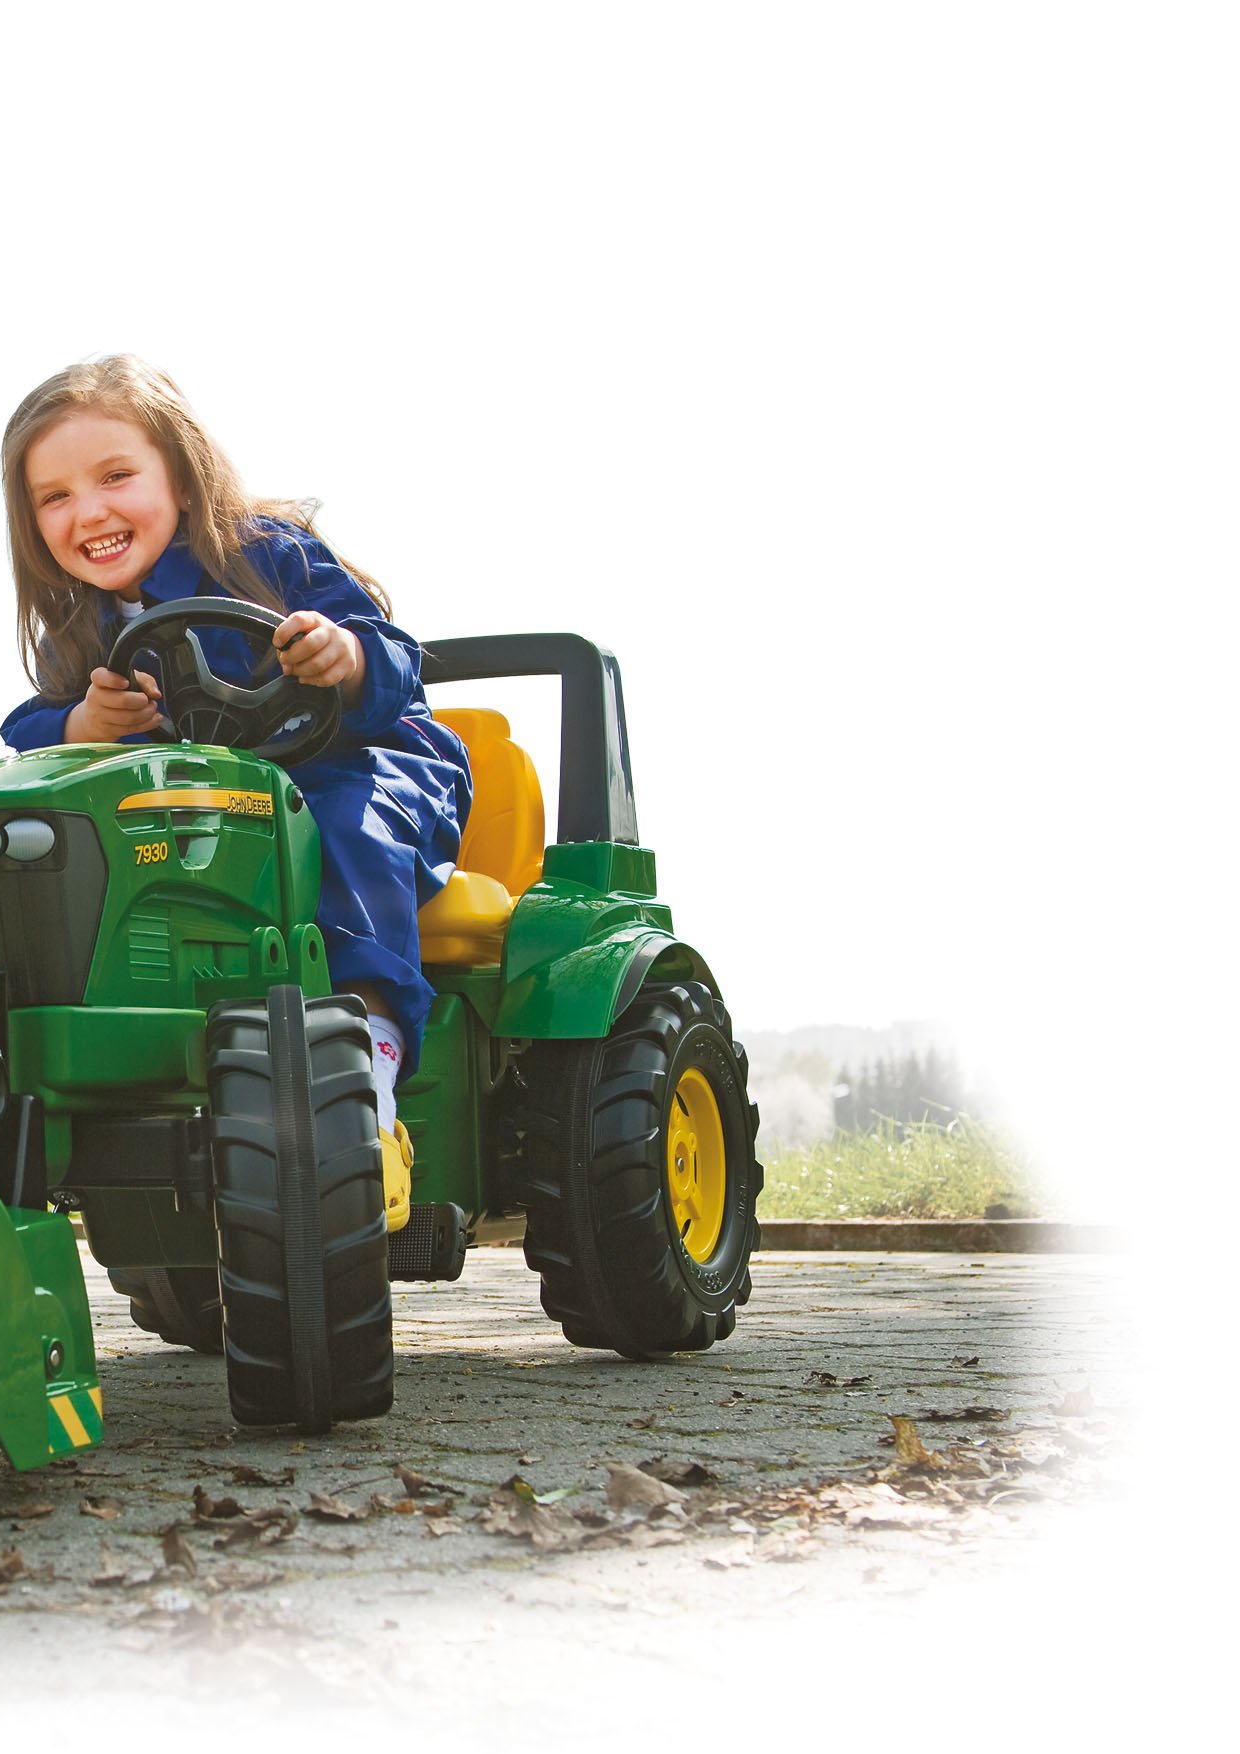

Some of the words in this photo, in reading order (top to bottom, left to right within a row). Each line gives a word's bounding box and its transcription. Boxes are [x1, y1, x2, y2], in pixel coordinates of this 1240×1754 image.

[227, 793, 246, 812] JOHN
[246, 796, 272, 813] DEERE
[135, 842, 168, 865] 7930
